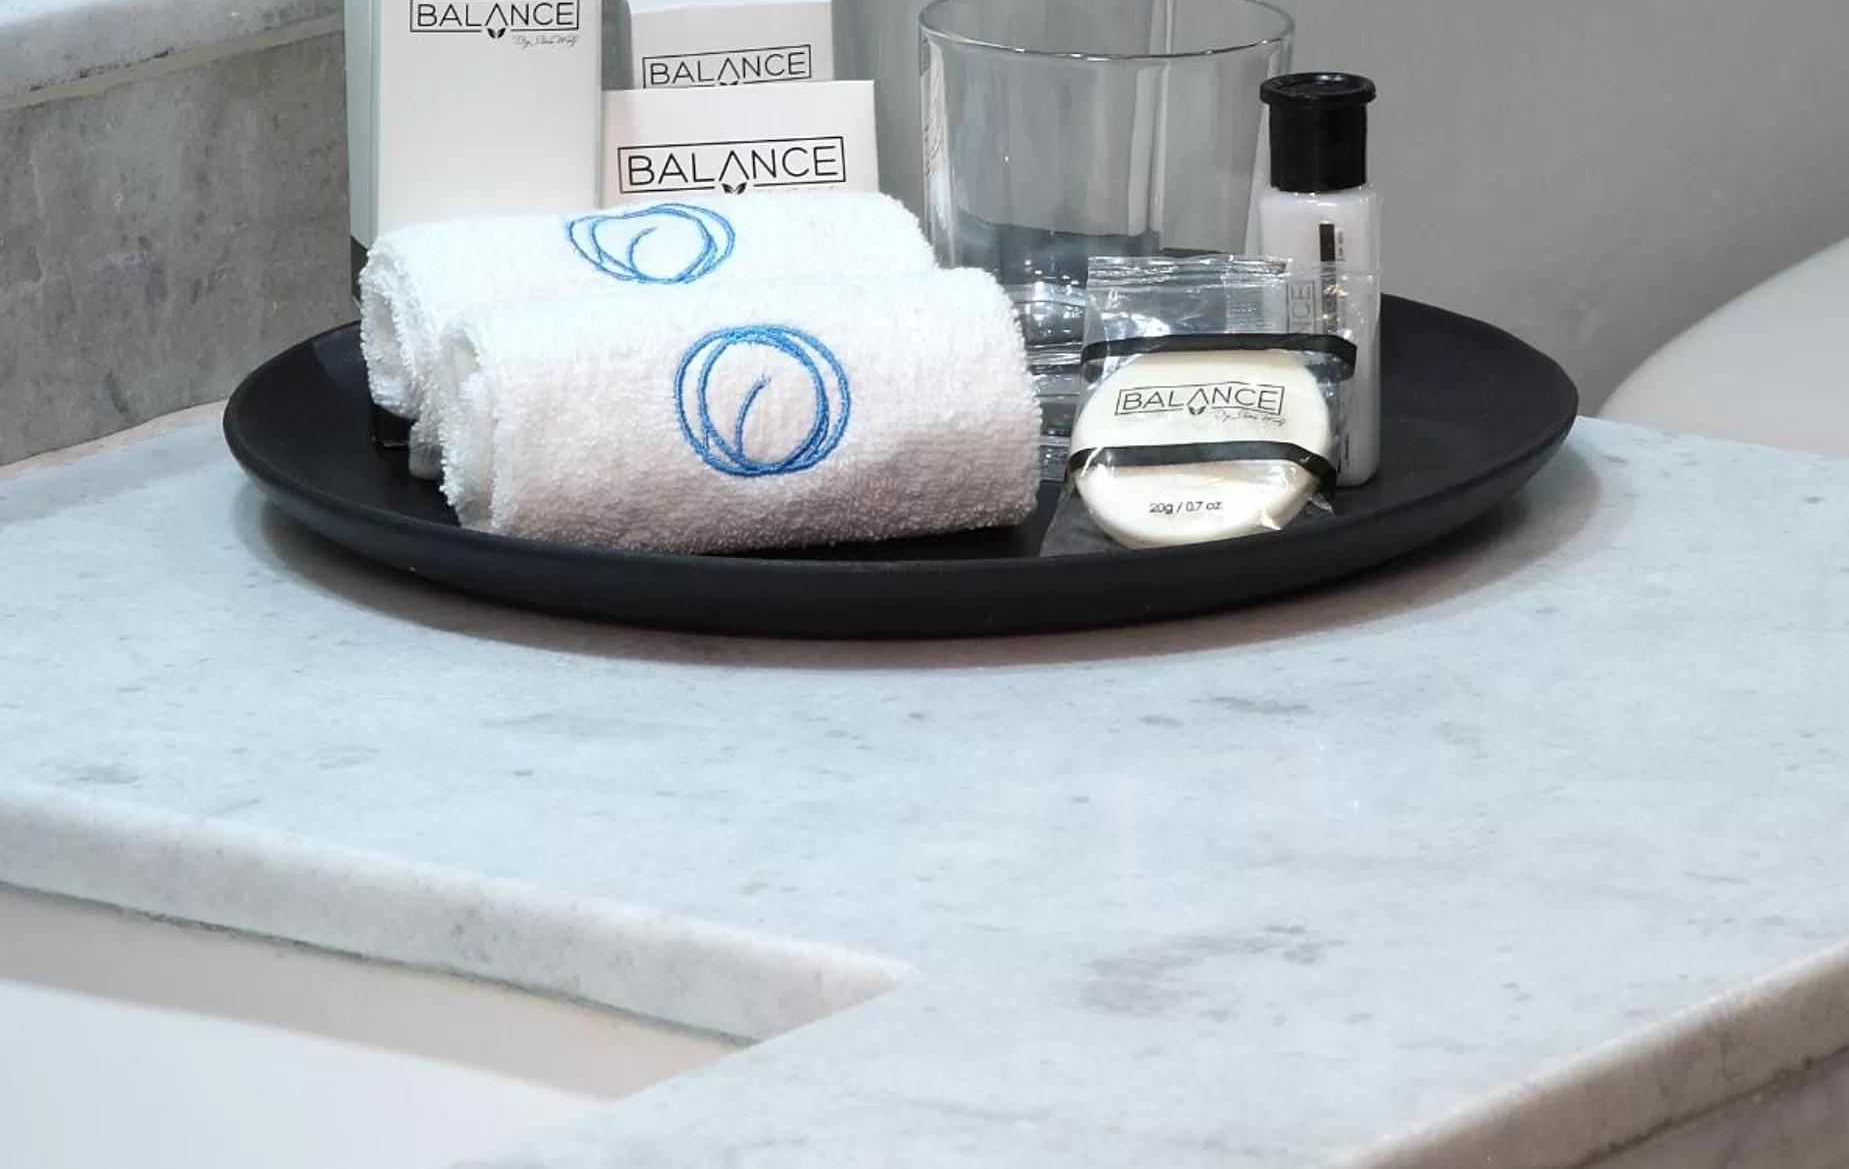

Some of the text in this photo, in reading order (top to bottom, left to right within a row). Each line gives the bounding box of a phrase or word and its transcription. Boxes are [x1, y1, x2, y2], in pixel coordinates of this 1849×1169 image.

[417, 2, 574, 27] BALANCE
[650, 52, 806, 85] BALANCE
[628, 146, 838, 186] BALANCE
[1123, 386, 1279, 410] BALANCE
[1149, 502, 1173, 514] 20g
